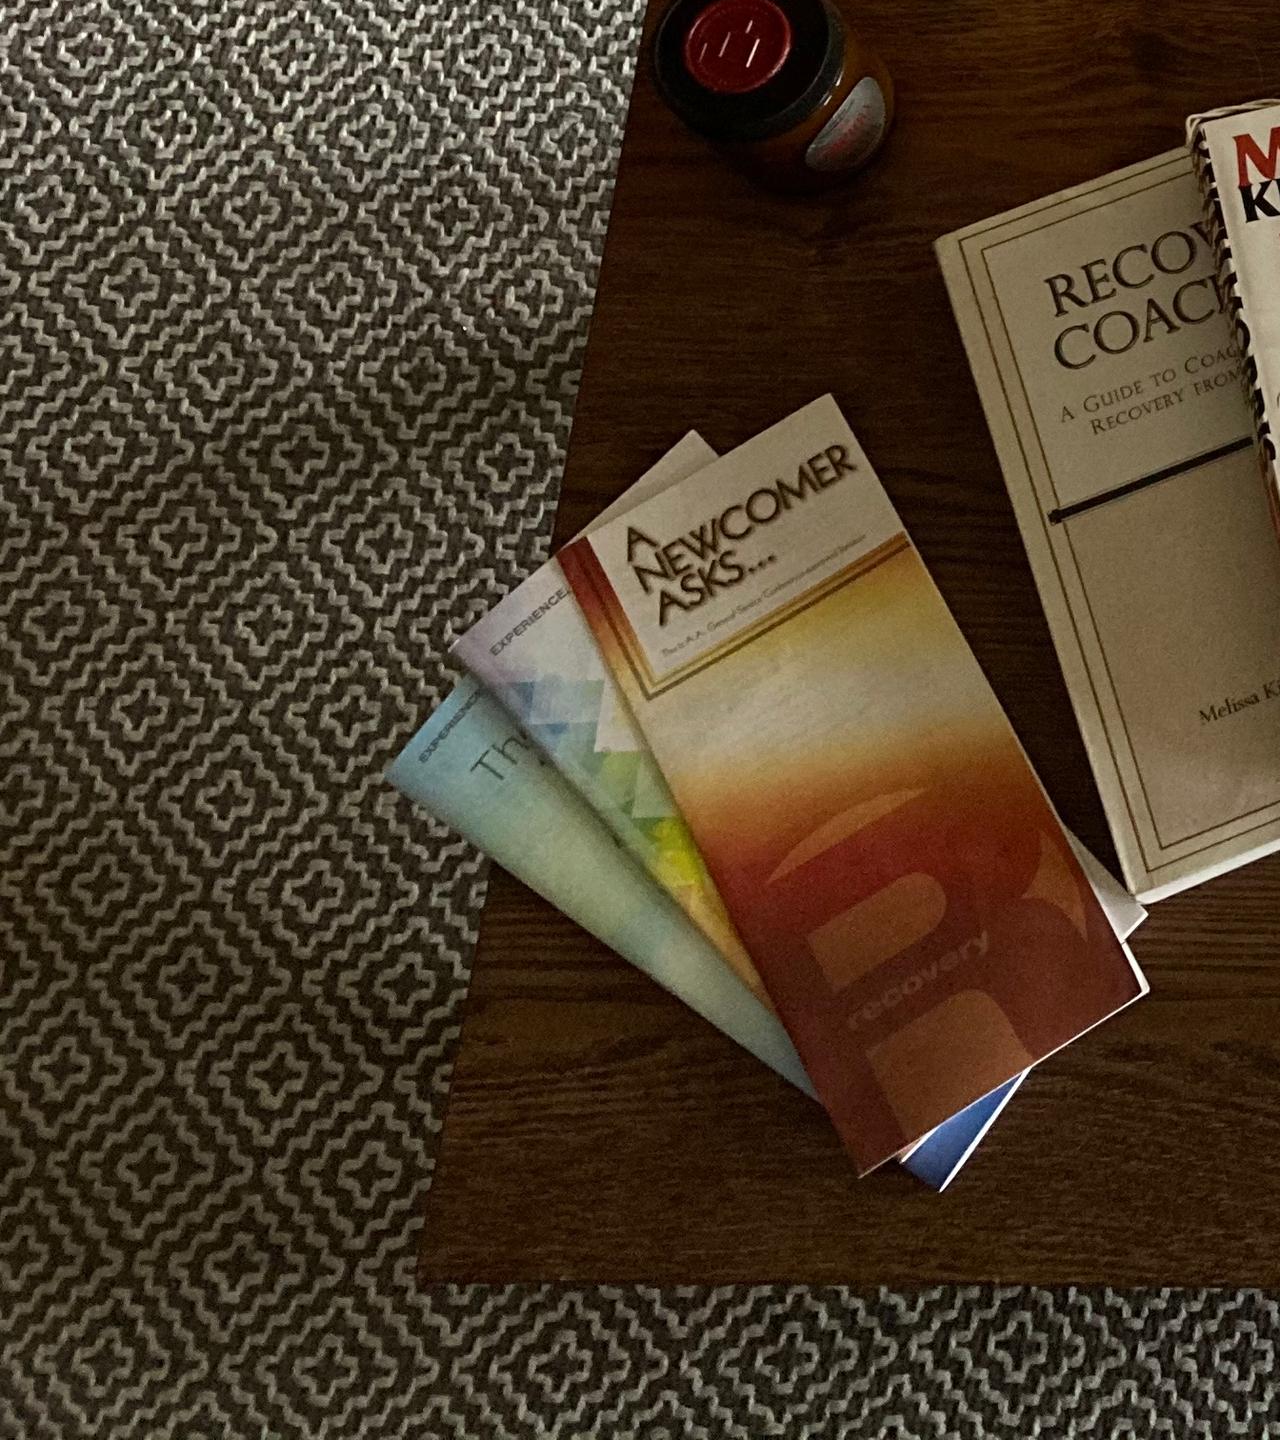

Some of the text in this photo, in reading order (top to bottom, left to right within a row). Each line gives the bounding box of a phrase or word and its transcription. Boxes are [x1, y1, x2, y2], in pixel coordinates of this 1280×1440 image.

[1060, 406, 1075, 423] A
[1083, 380, 1144, 413] GUIDE
[1149, 368, 1176, 387] TO
[1090, 388, 1184, 436] RECOVERY
[633, 444, 858, 595] NEWCOMER
[627, 526, 658, 563] A
[1199, 692, 1260, 726] Melissa
